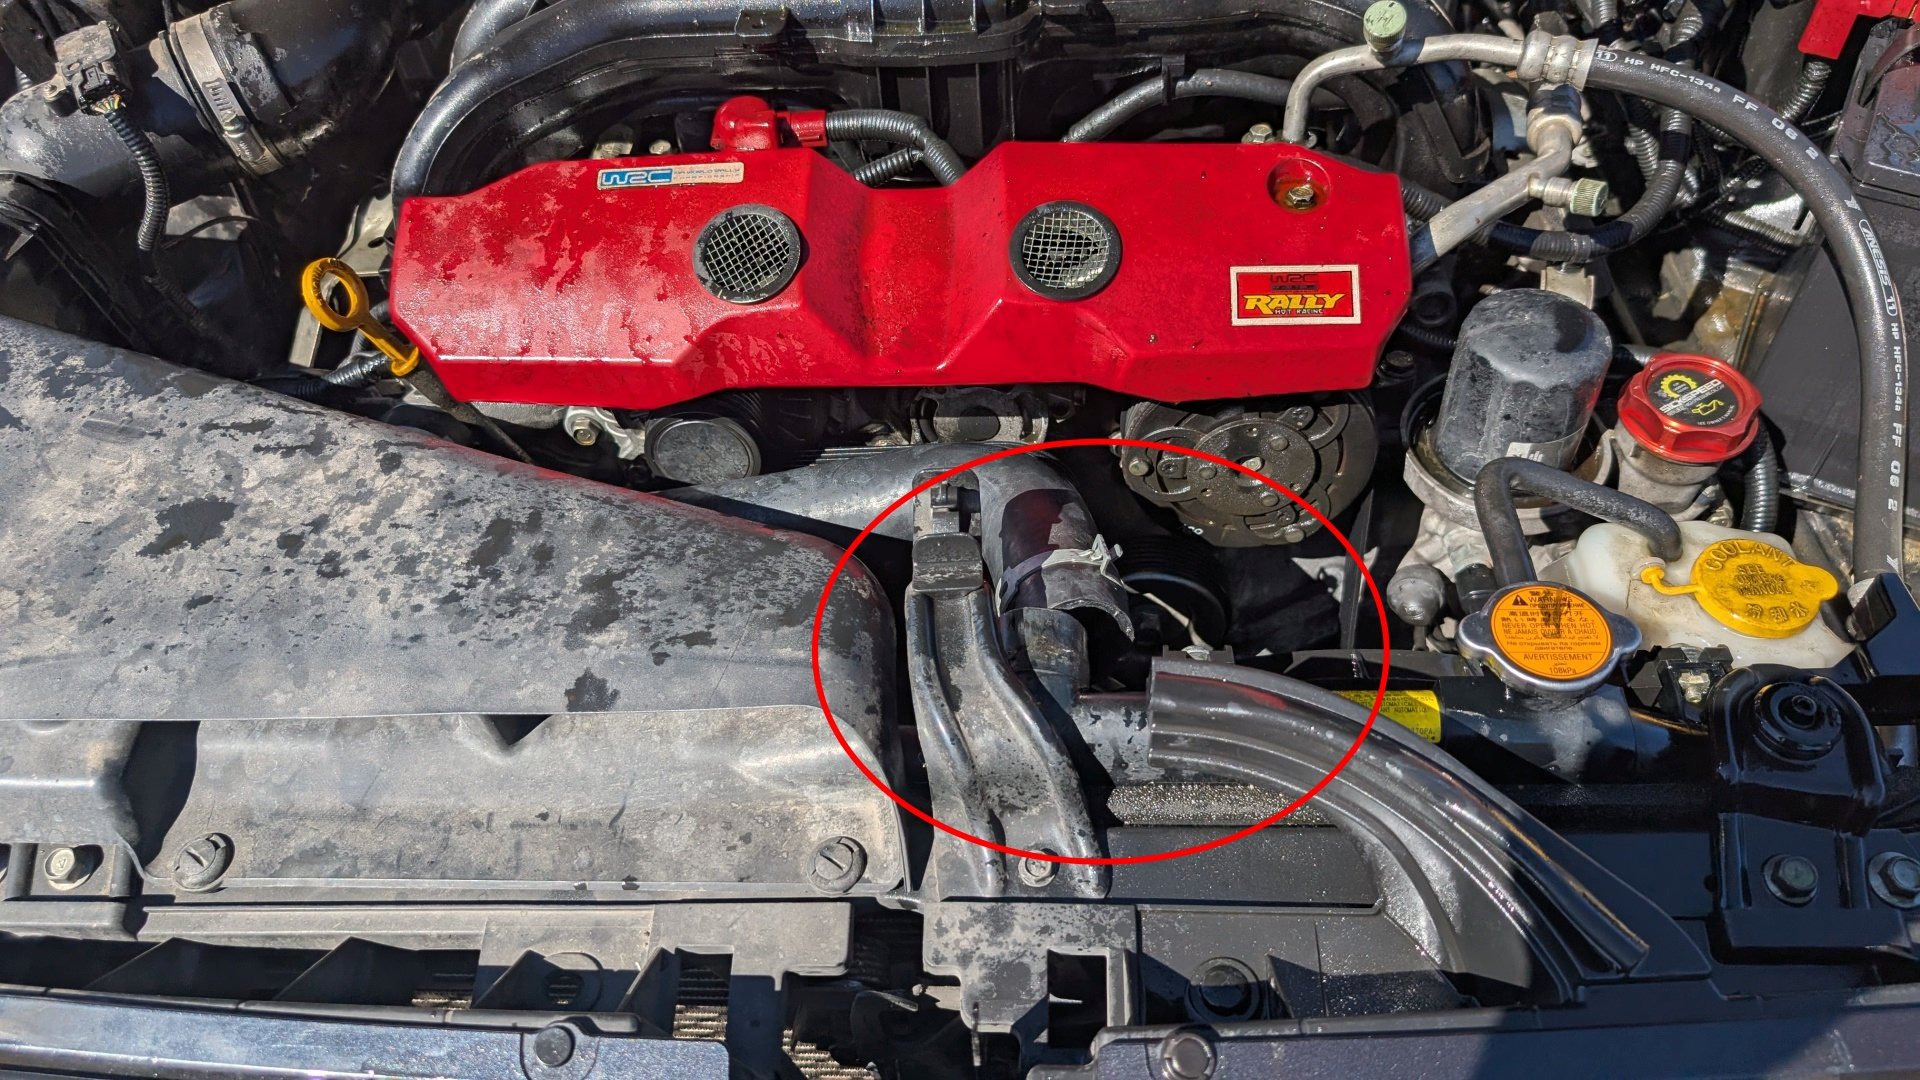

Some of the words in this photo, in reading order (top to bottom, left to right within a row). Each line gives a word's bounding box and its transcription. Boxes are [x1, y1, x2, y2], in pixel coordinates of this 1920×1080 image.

[1624, 57, 1644, 67] HP
[1650, 63, 1721, 94] HFC-134a
[1732, 93, 1759, 112] FF
[1805, 146, 1819, 160] 2
[1242, 293, 1347, 315] RALLY
[1890, 321, 1900, 340] HP
[1892, 345, 1903, 412] HFC-134a
[1892, 422, 1902, 448] FF
[1887, 498, 1898, 512] 2
[1705, 540, 1798, 572] COOLANT
[1738, 564, 1764, 575] SEE
[1738, 584, 1792, 596] MANUAL
[1528, 596, 1573, 604] WARNNG
[1523, 653, 1593, 661] AVERTISSEMENT
[1548, 667, 1577, 675] 108kPa
